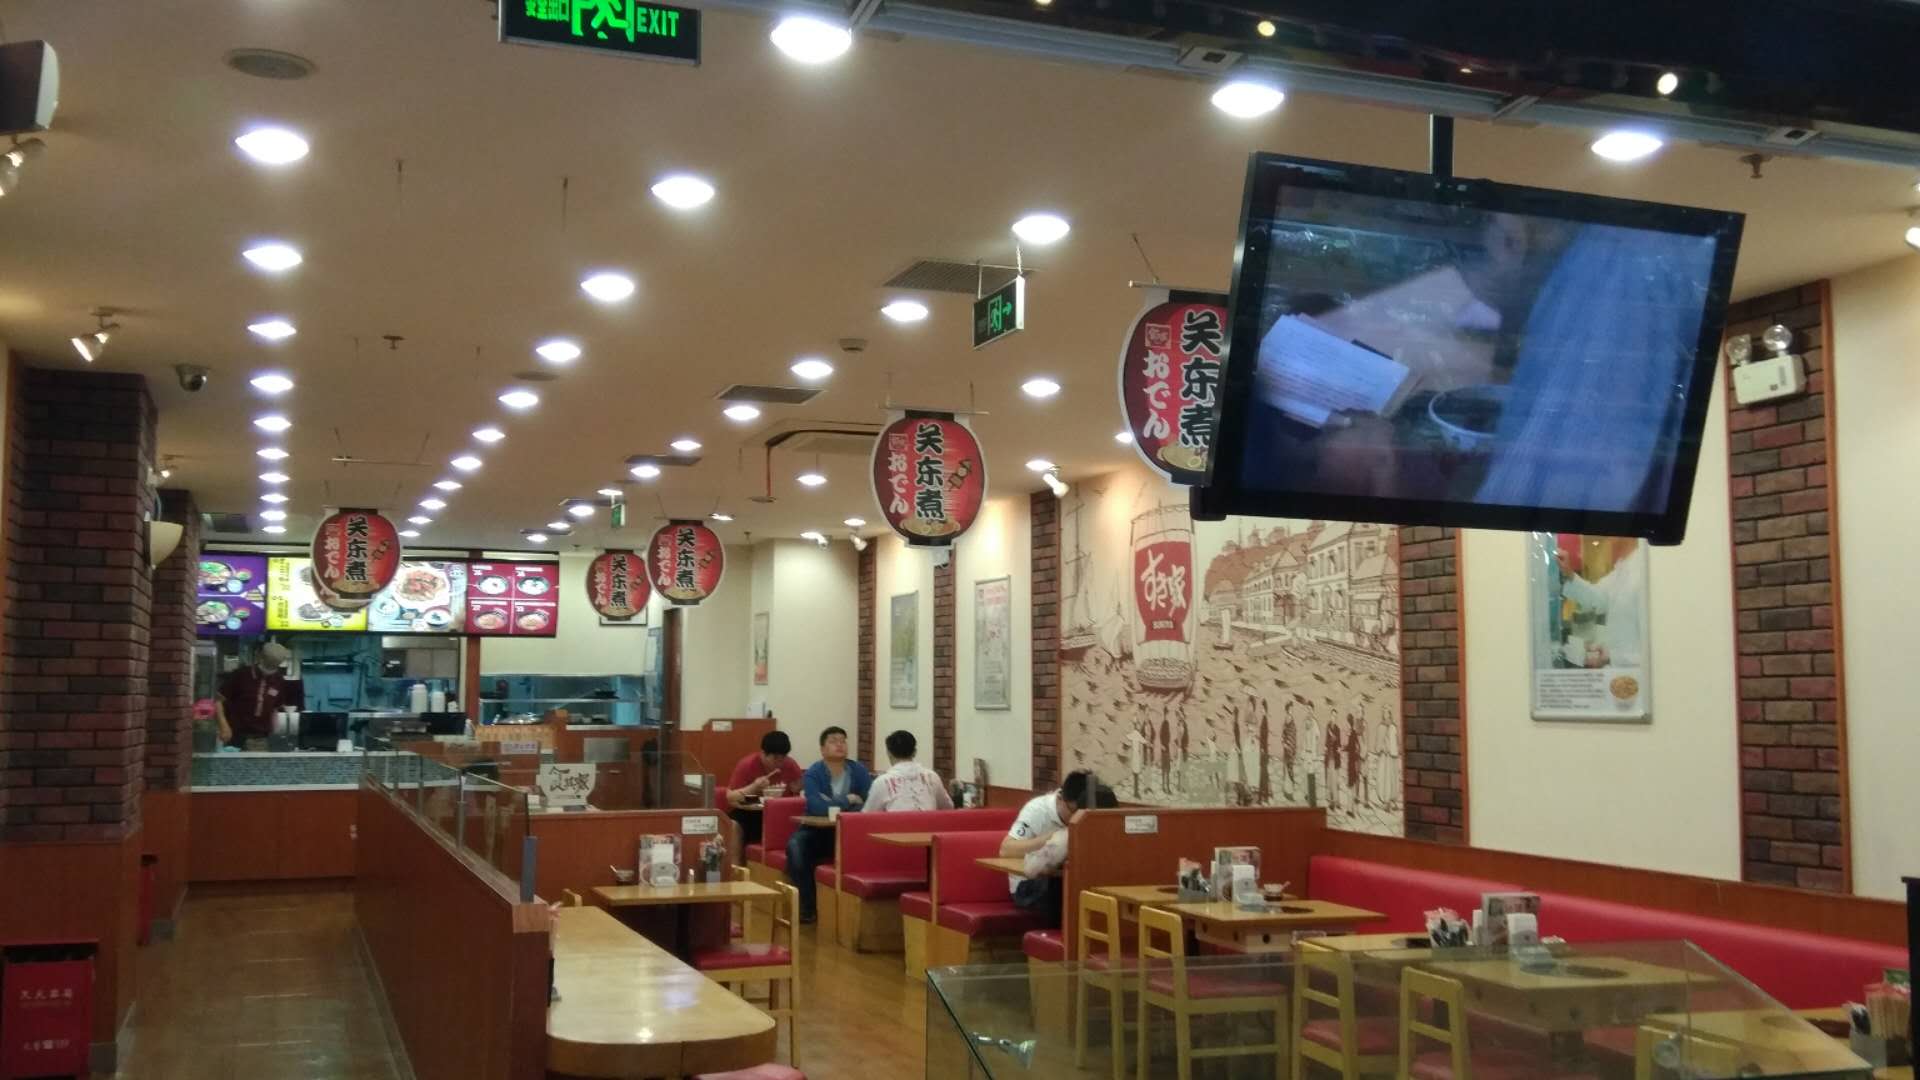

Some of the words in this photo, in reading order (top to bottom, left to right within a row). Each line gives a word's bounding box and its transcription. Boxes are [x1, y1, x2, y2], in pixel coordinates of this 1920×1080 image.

[636, 6, 680, 37] EXIT
[1143, 350, 1170, 440] おでん
[1181, 309, 1225, 447] 关东煮
[888, 452, 909, 514] おでん
[915, 423, 945, 519] 关东煮
[345, 514, 369, 581] 关东煮
[675, 528, 697, 589] 关东煮
[610, 555, 628, 608] 关东煮
